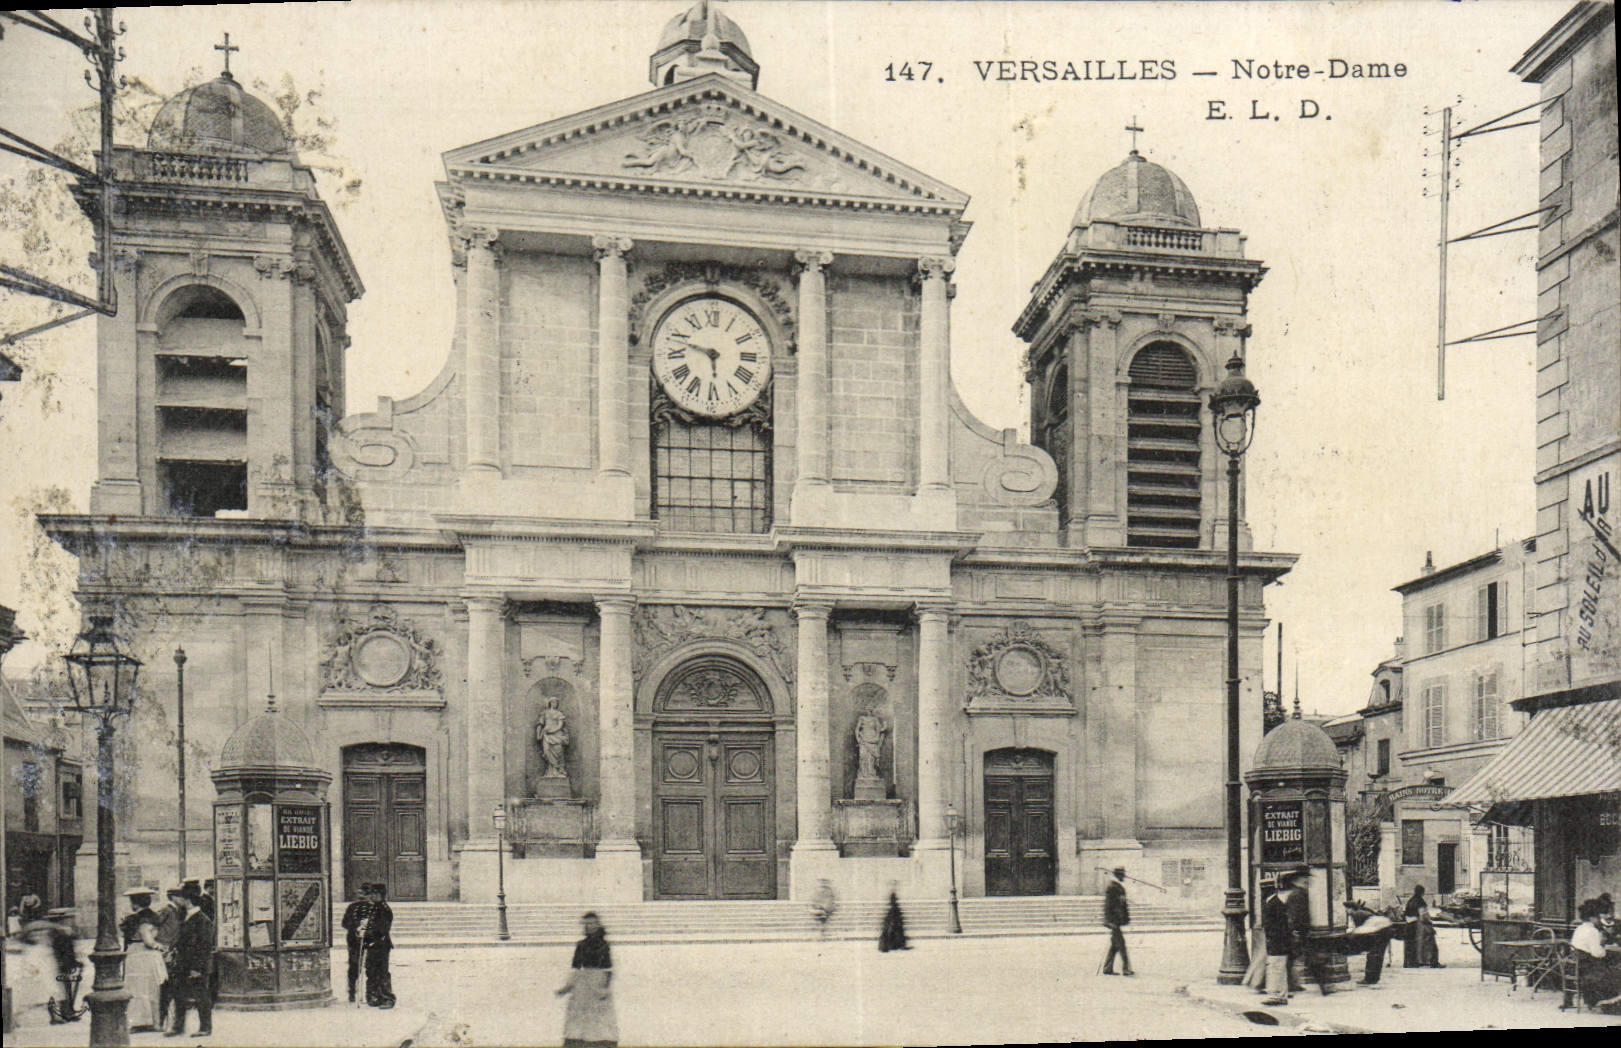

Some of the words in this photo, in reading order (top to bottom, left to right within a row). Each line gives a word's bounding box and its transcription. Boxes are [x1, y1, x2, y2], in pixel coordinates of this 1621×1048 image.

[1583, 471, 1610, 519] AU
[280, 816, 316, 825] EXTRAIT
[1264, 810, 1300, 820] EXTRAIT
[280, 834, 318, 849] LIEBIG
[1265, 829, 1302, 842] LIEBIG
